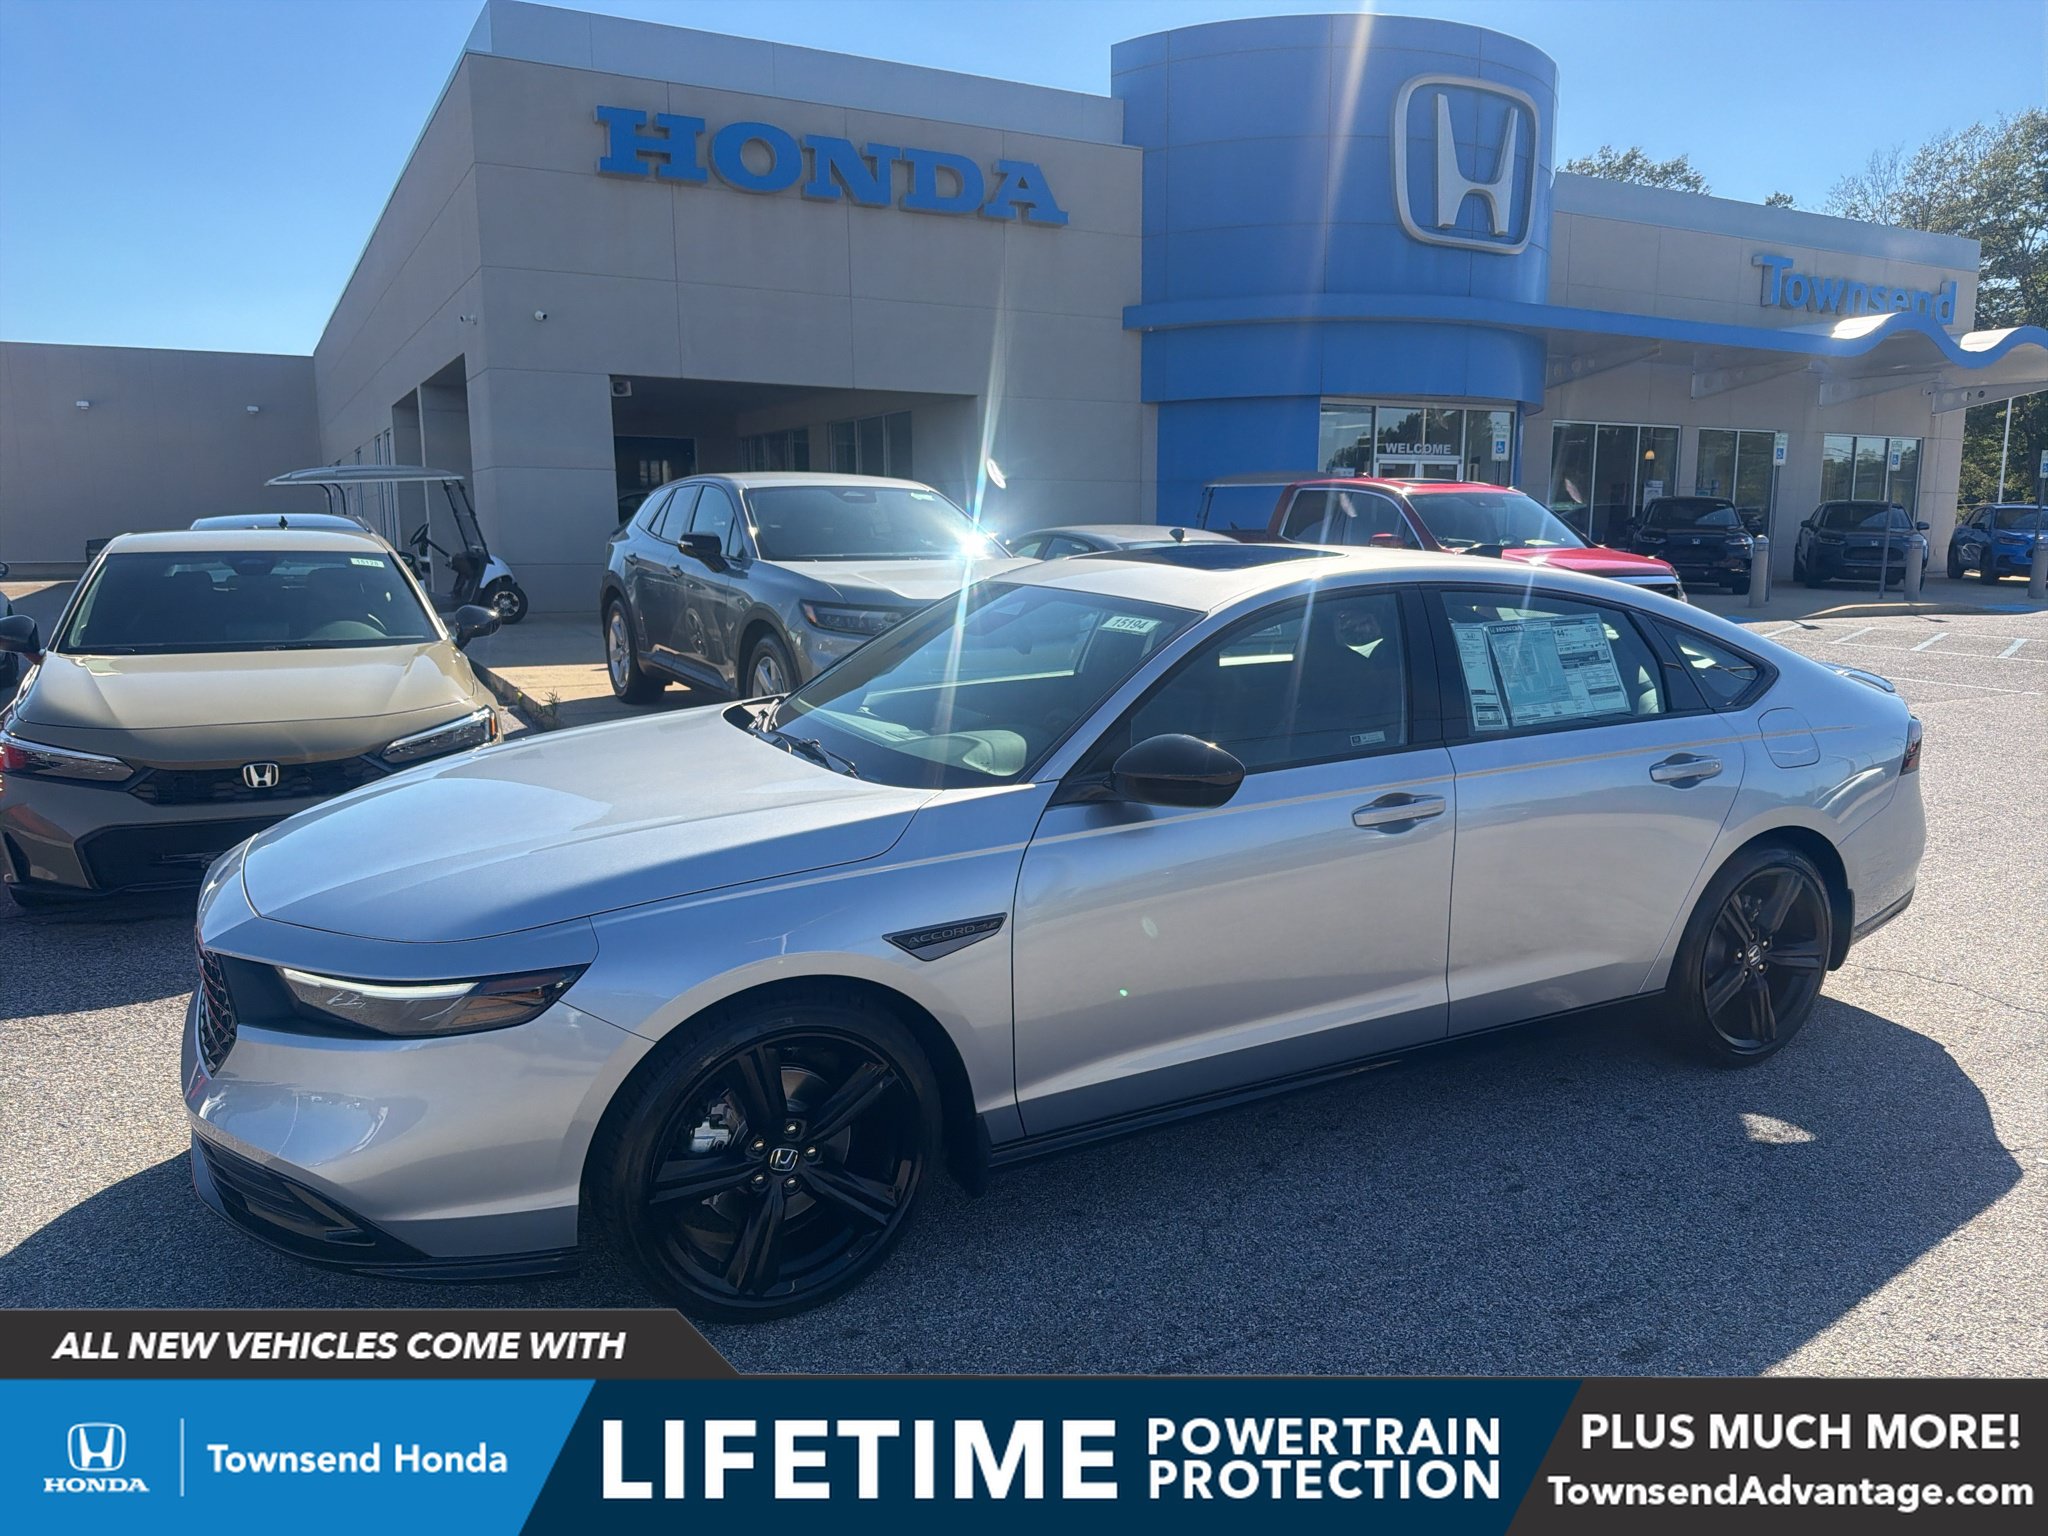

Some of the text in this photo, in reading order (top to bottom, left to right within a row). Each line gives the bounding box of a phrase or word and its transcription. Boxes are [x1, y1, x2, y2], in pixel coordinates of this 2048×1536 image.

[595, 105, 1069, 226] HONDA
[1754, 254, 1958, 326] Townsend
[1385, 442, 1452, 455] WELCOME
[1111, 617, 1150, 629] 15194
[1496, 624, 1523, 633] HONDA
[907, 924, 976, 946] ACCORD
